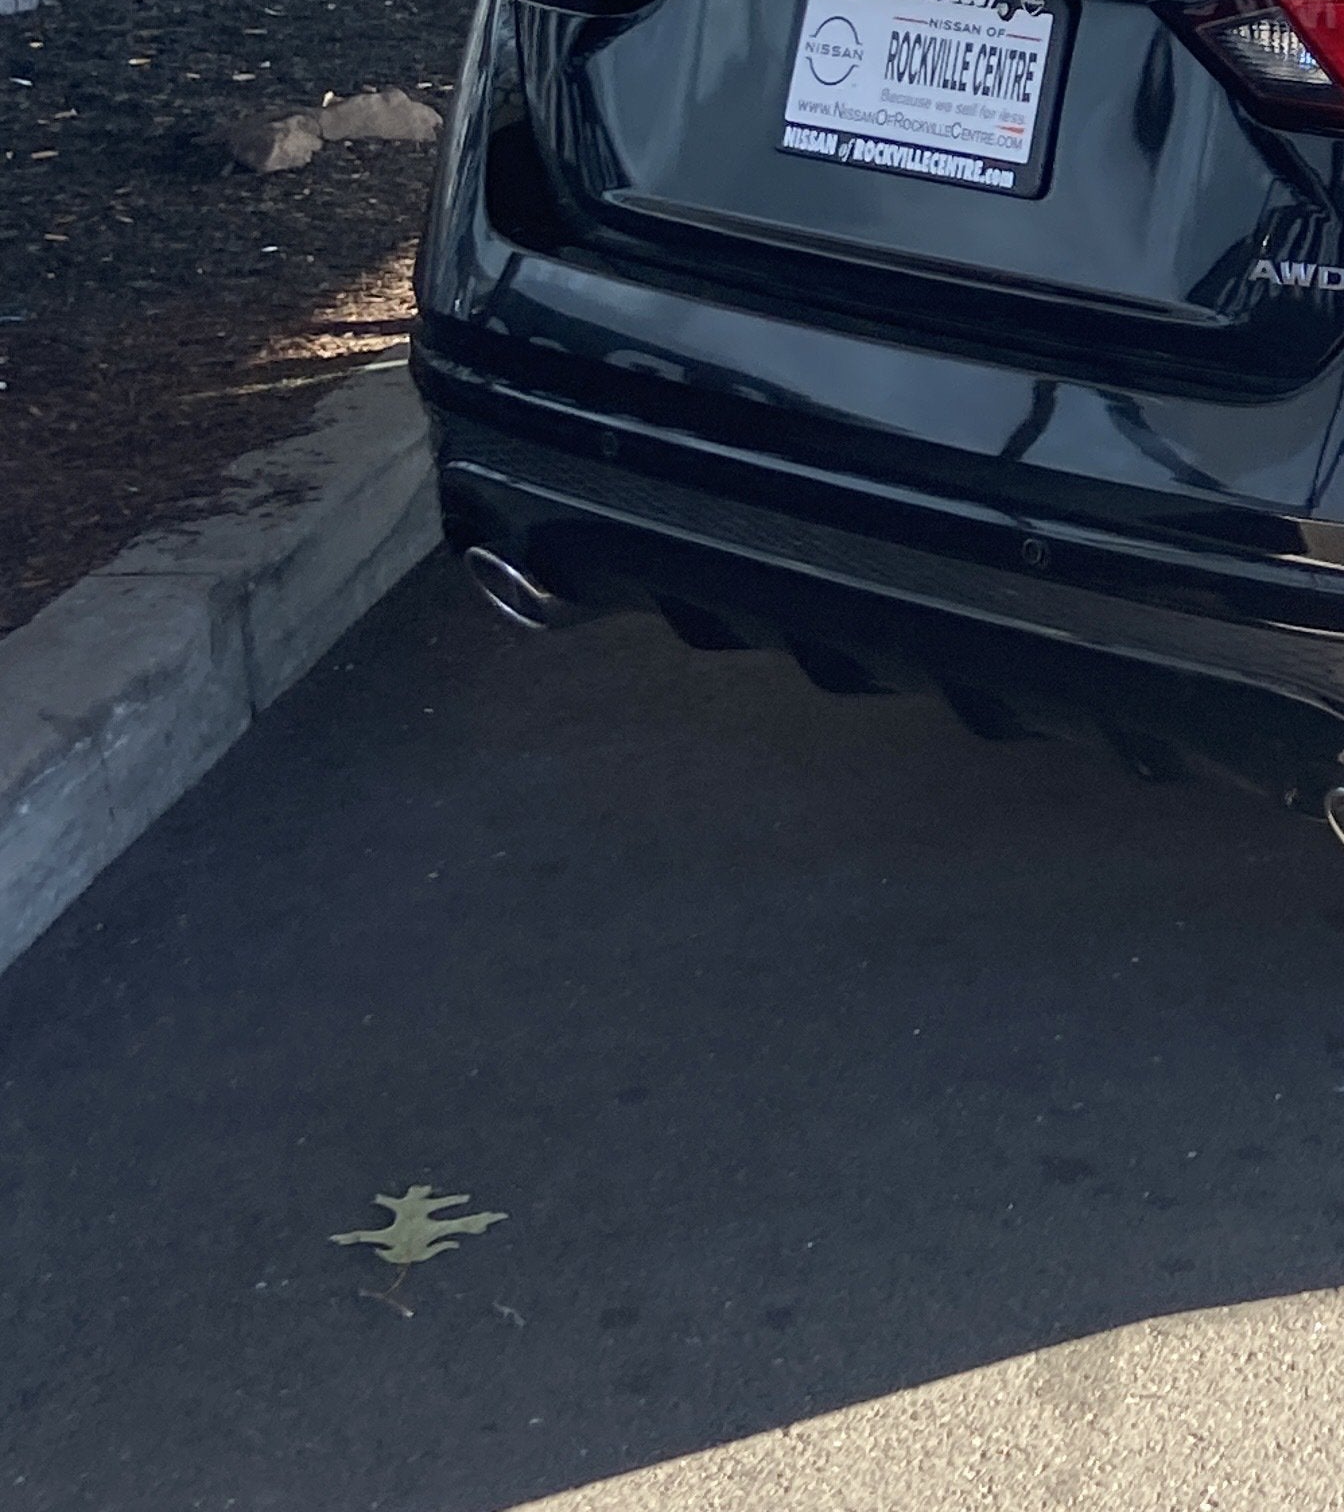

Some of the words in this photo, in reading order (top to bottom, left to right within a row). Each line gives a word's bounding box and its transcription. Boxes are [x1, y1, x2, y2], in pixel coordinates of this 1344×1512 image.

[928, 17, 982, 35] NISSAN
[985, 26, 1007, 39] OF
[804, 40, 864, 62] NISSAN
[884, 30, 974, 92] ROCKVILLE
[970, 42, 1039, 103] CENTRE
[935, 97, 953, 112] we
[978, 100, 997, 120] for
[783, 125, 839, 156] NISSAN
[838, 139, 856, 163] of
[853, 139, 1016, 189] ROCKVILLECENTRE.com
